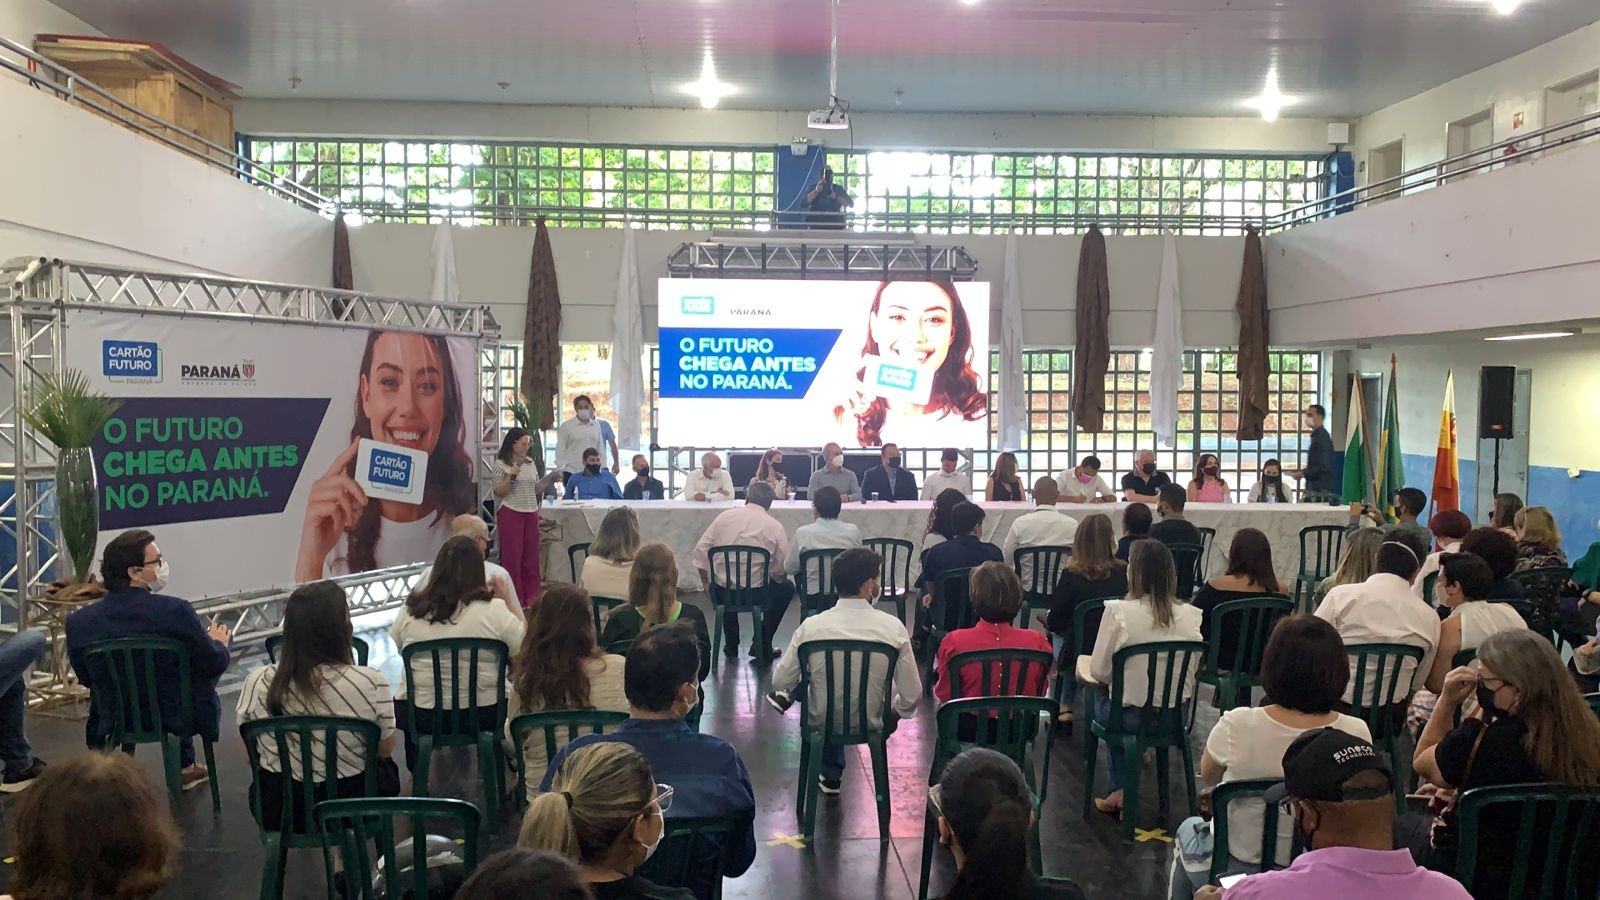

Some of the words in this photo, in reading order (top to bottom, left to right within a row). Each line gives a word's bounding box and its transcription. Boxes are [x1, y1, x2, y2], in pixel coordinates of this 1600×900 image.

[108, 345, 152, 358] CARTÃO
[679, 337, 695, 353] O
[698, 337, 774, 354] FUTURO
[108, 359, 152, 371] FUTURO
[181, 363, 241, 379] PARANÁ
[678, 355, 747, 372] CHEGA
[750, 356, 817, 373] ANTES
[679, 373, 709, 390] NO
[712, 370, 793, 390] PARANÁ.
[103, 418, 127, 445] O
[135, 416, 243, 442] FUTURO
[103, 448, 208, 478] CHEGA
[213, 444, 299, 471] ANTES
[375, 455, 408, 470] CARTÃO
[373, 466, 406, 481] FUTURO
[105, 482, 150, 511] NO
[157, 468, 269, 506] PARANÁ.
